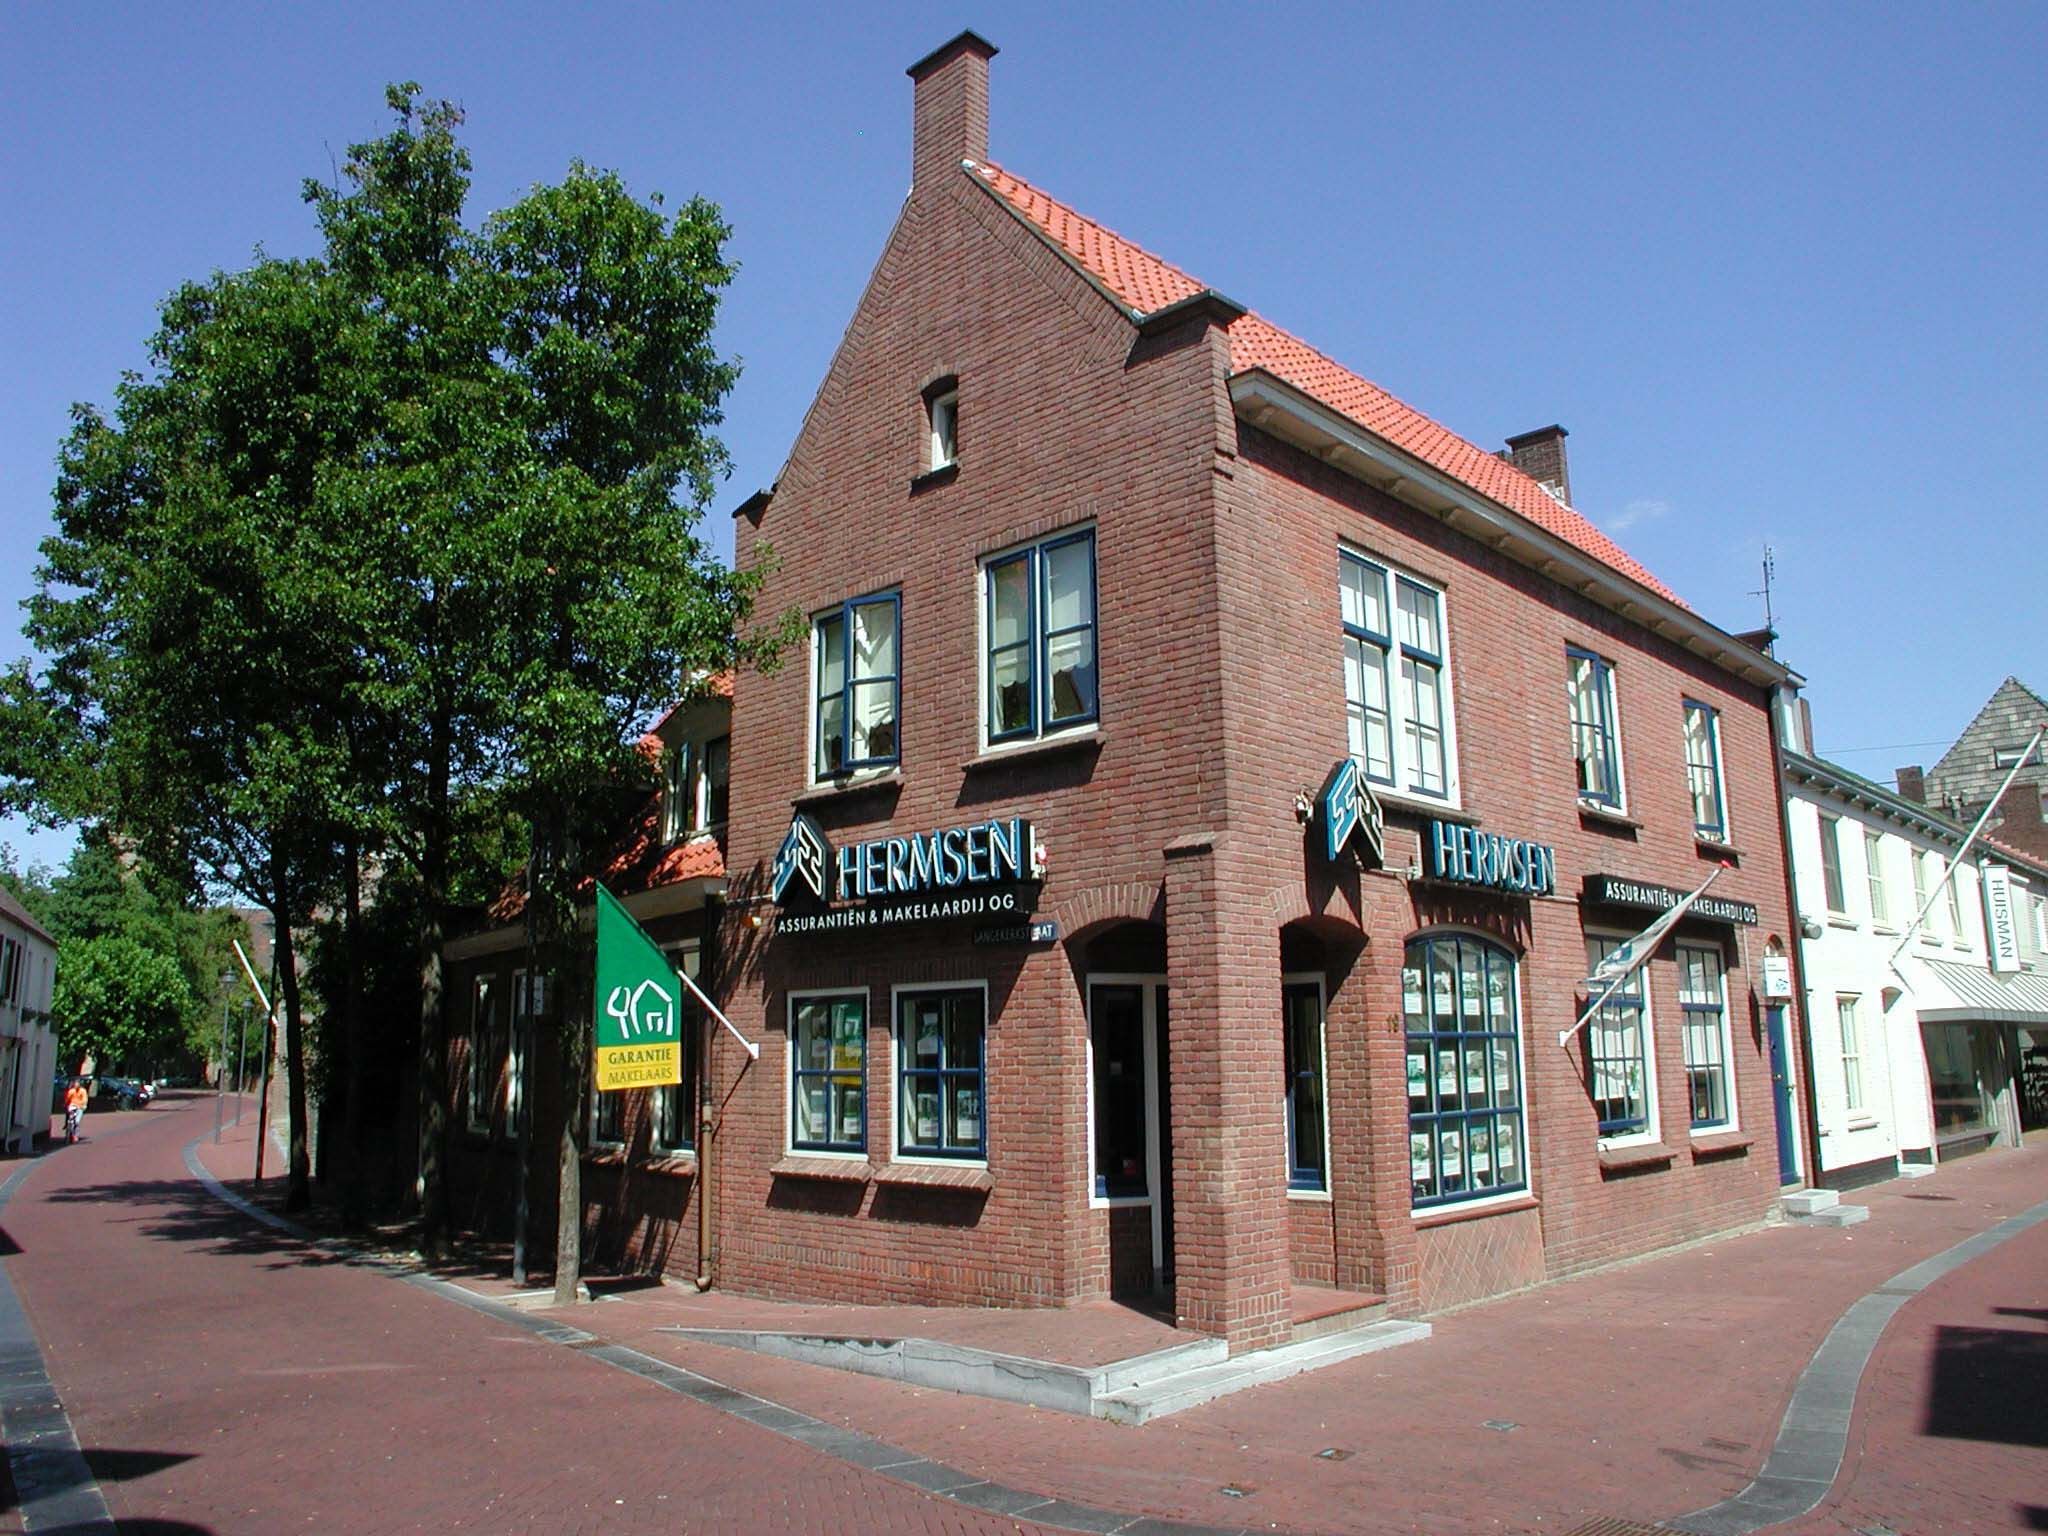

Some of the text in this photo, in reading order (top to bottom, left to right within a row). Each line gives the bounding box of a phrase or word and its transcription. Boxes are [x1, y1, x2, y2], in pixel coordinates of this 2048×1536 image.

[838, 817, 1022, 899] HERMSEN
[1433, 820, 1557, 896] HERMSEN
[778, 894, 1014, 933] ASSURANTIËN & MAKELAARDIJ OG
[1605, 881, 1676, 908] ASSURANTIËN
[1743, 906, 1757, 923] OG
[1991, 879, 2014, 958] HUISMAN
[608, 1048, 672, 1065] GARANTIE
[608, 1067, 673, 1084] MAKELAARS
